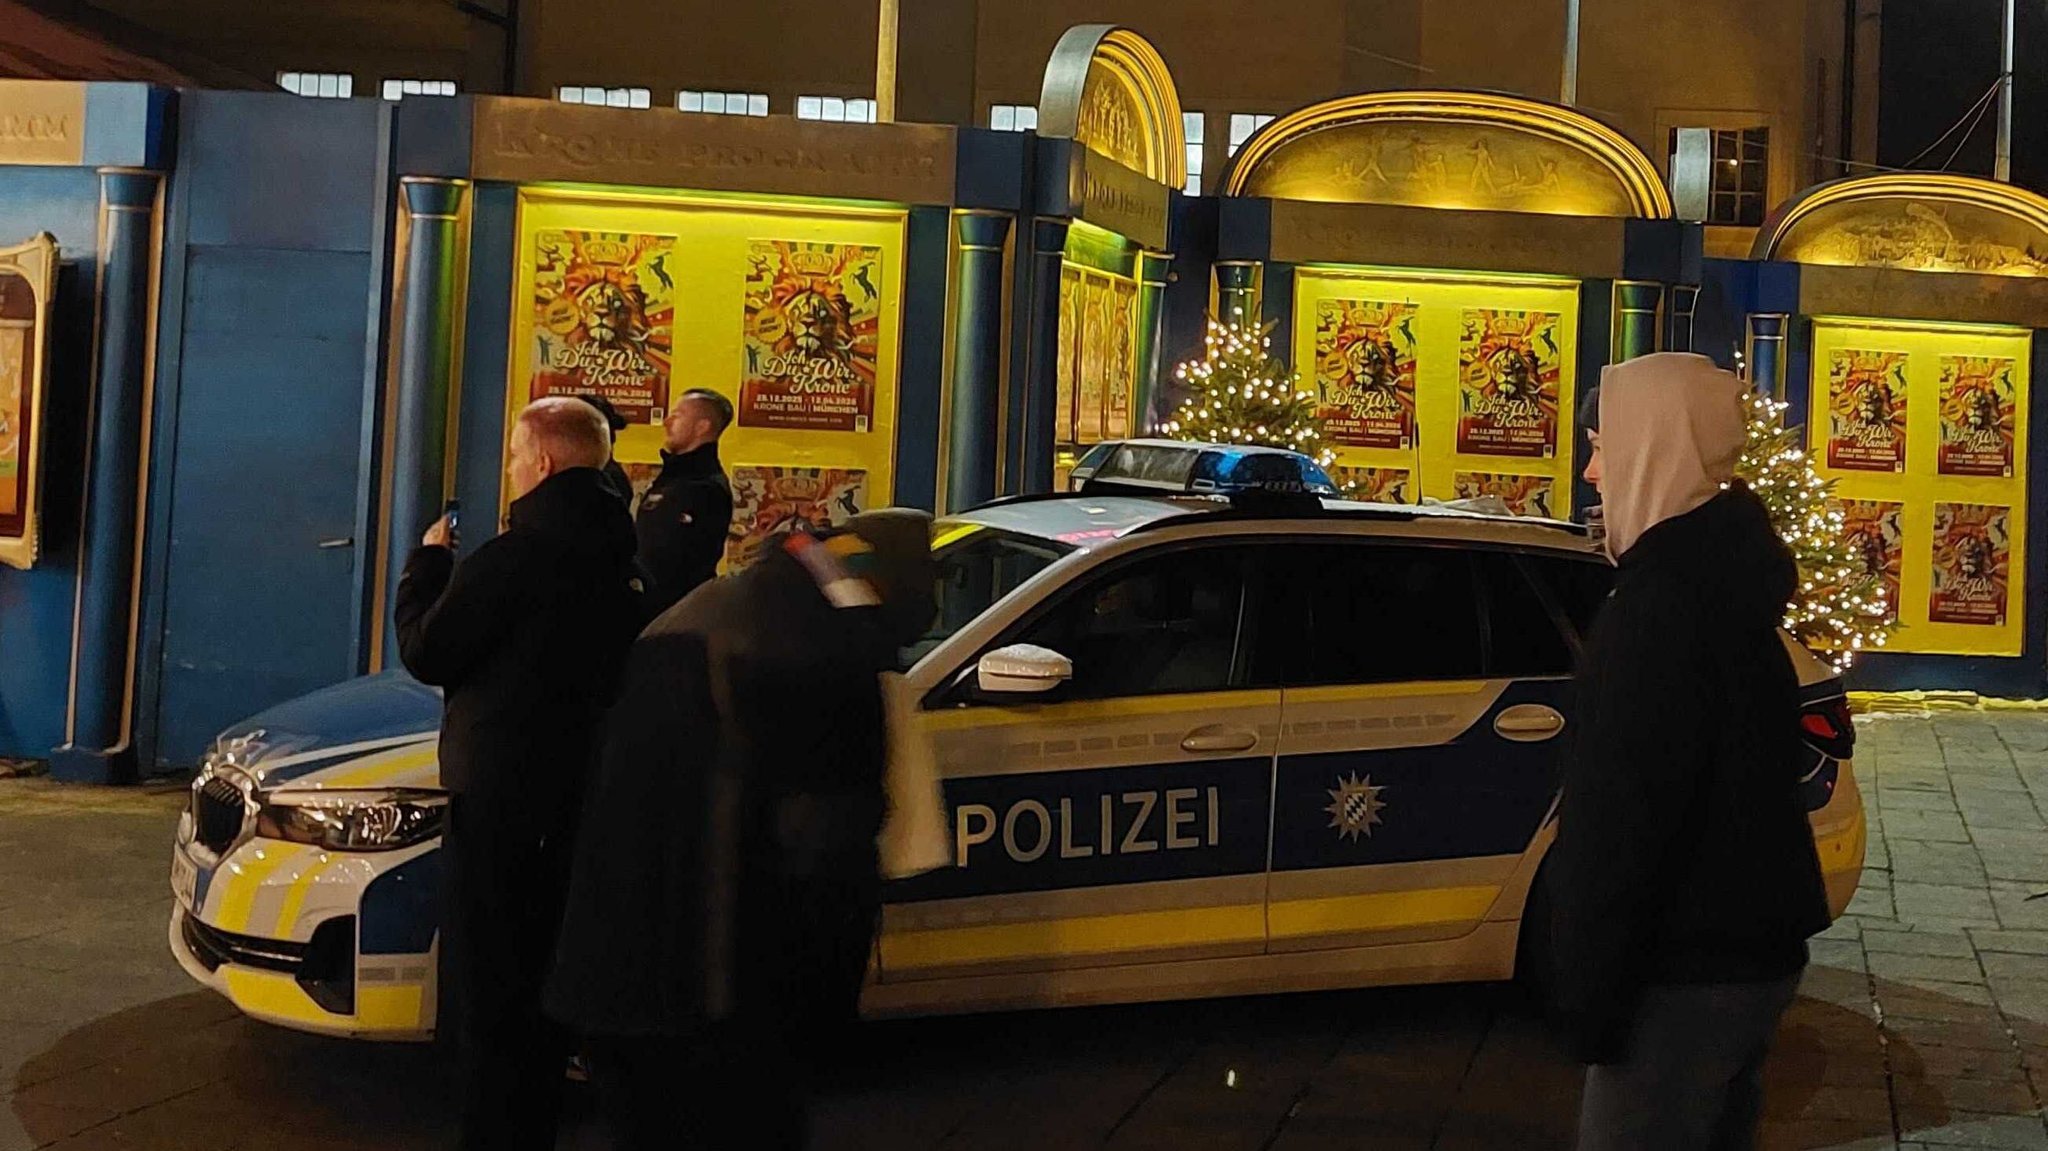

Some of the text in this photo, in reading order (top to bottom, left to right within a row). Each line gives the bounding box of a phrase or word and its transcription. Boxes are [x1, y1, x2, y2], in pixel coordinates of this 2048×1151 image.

[582, 365, 646, 387] Krone
[789, 373, 851, 395] Krone
[753, 402, 785, 413] KRONE
[787, 403, 806, 413] BAU
[813, 405, 859, 415] MÜNCHEN
[1350, 402, 1397, 420] Krone
[1493, 411, 1540, 429] Krone
[956, 786, 1219, 868] POLIZEI
